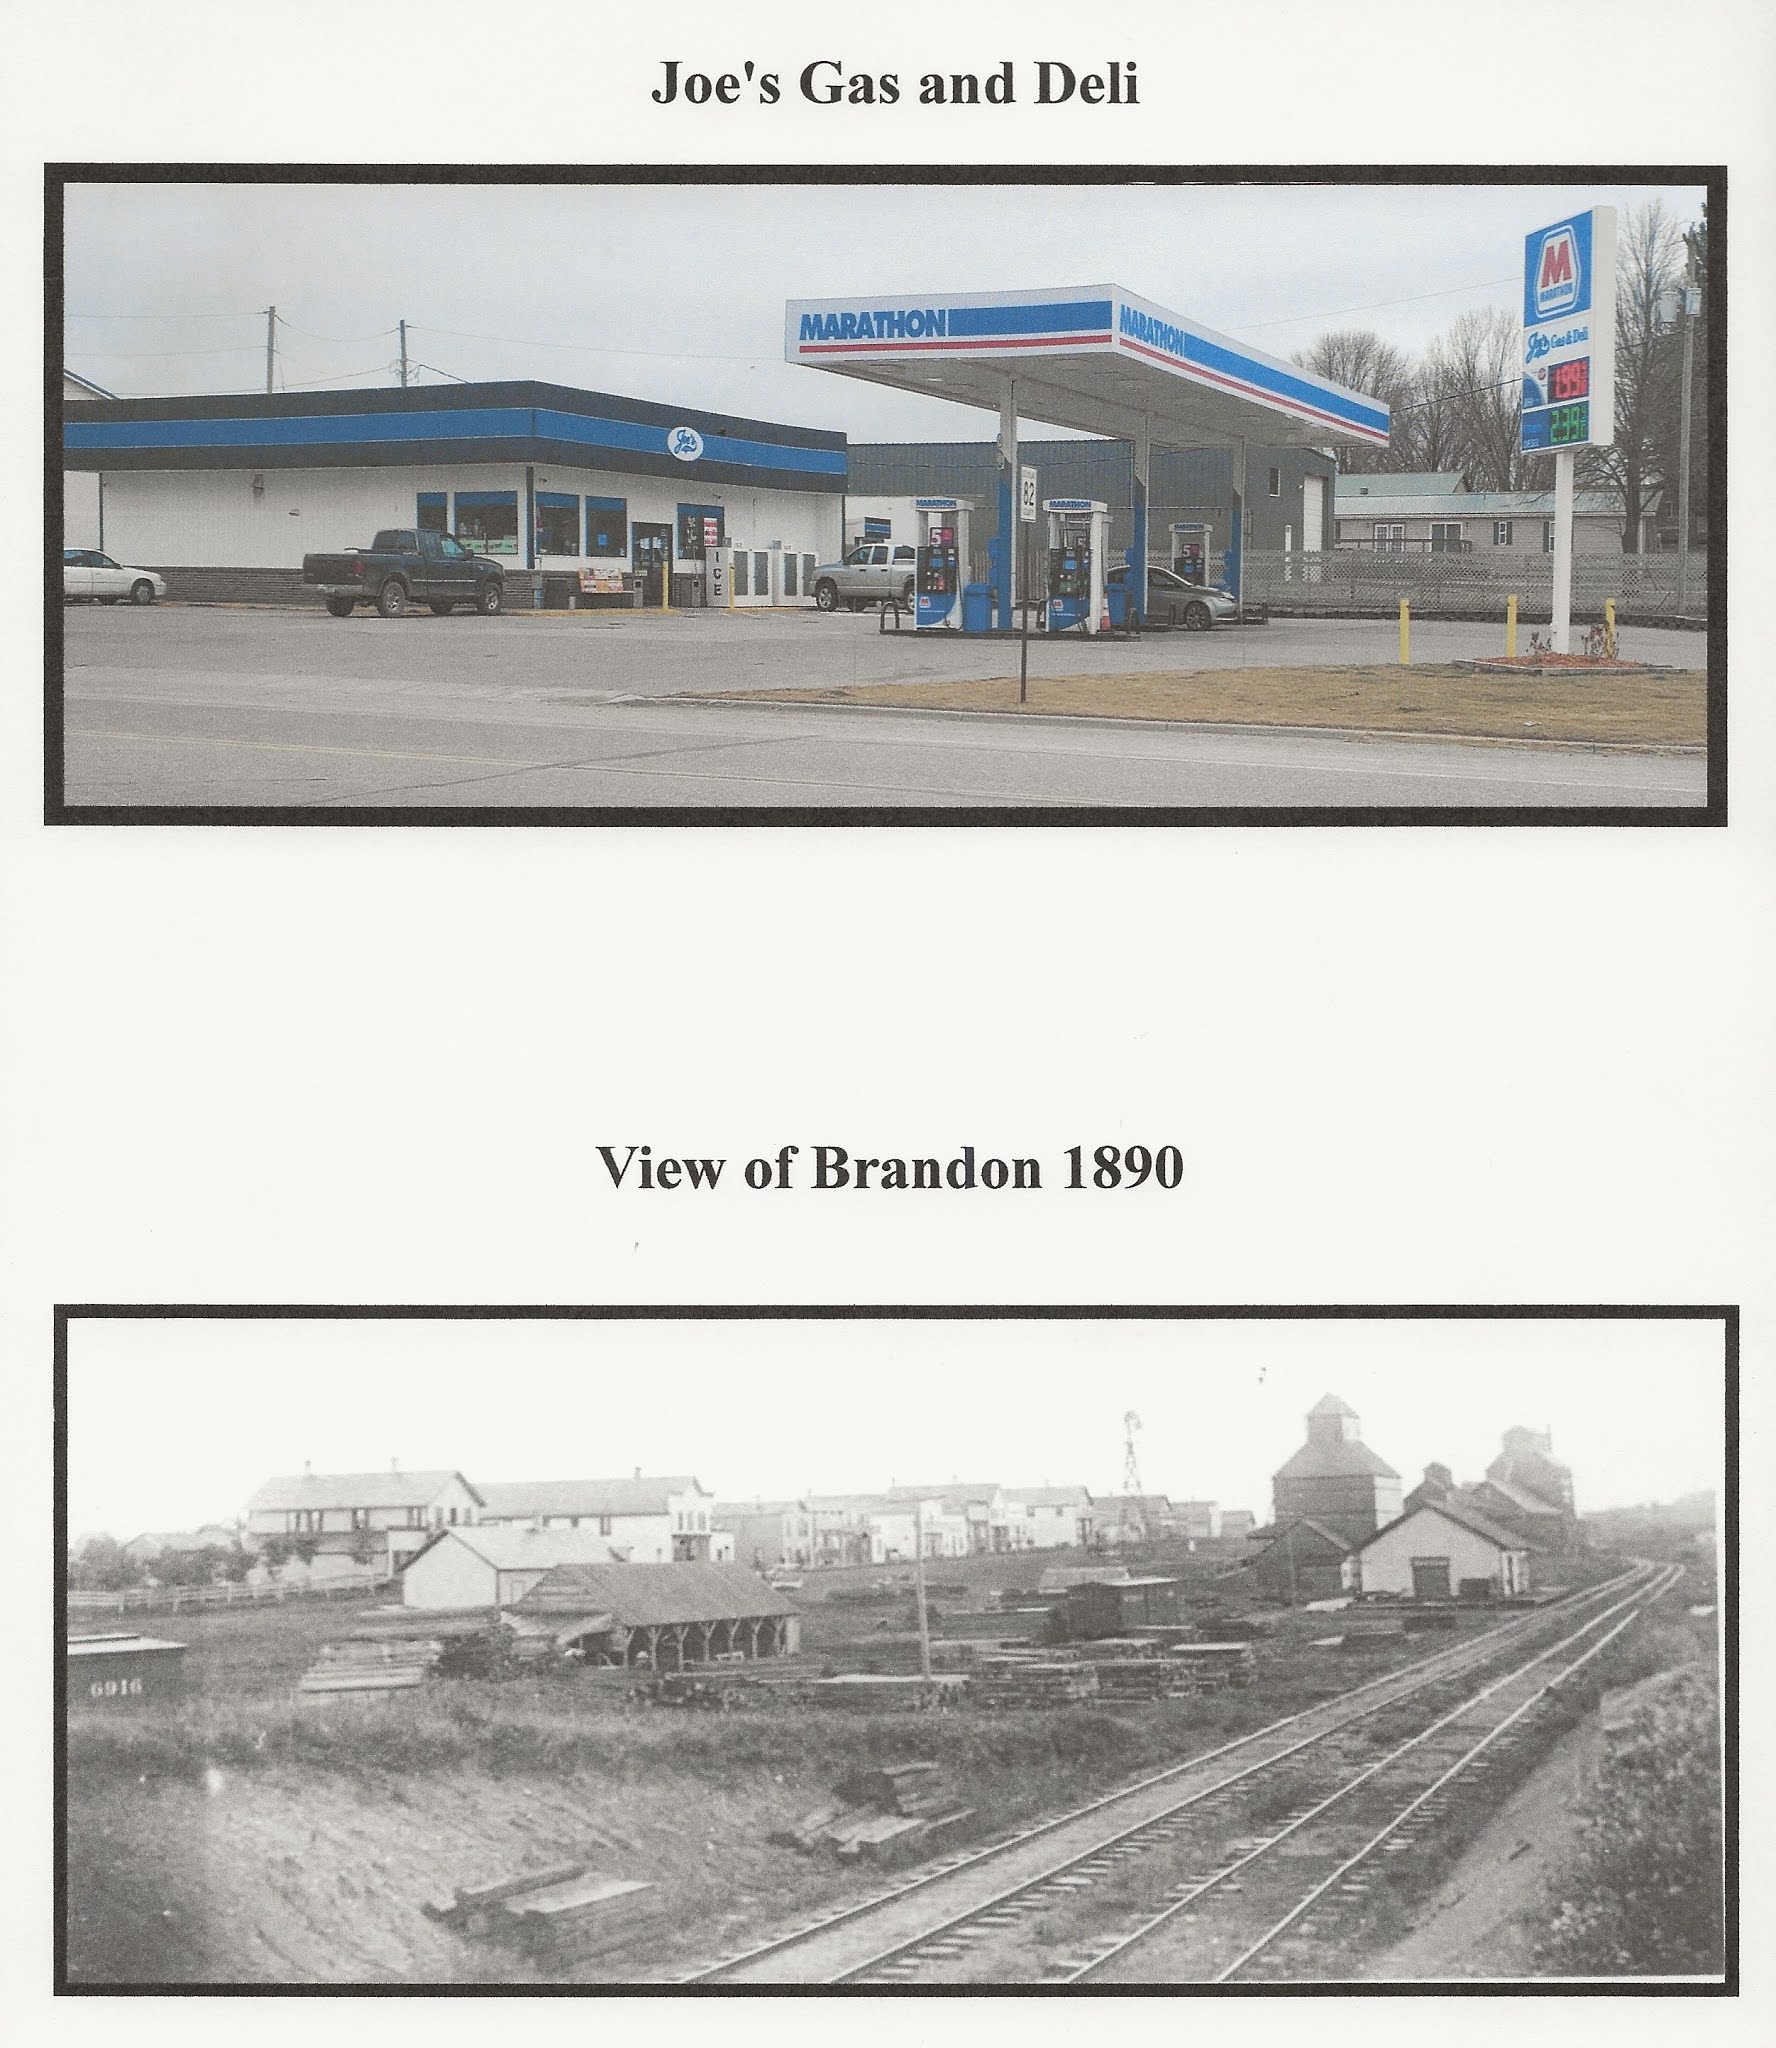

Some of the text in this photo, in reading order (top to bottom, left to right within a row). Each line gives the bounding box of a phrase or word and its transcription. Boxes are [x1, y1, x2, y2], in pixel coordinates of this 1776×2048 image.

[651, 60, 1141, 105] Joe's Gas and Deli
[1541, 240, 1572, 288] M
[798, 308, 947, 342] MARATHON
[1119, 303, 1186, 357] MARATHON
[916, 499, 957, 508] MARATHON
[1023, 481, 1035, 506] 82
[1049, 500, 1092, 509] MARATHON
[1182, 545, 1191, 558] 5
[712, 551, 723, 597] ICE
[594, 1145, 1184, 1190] View of Brandon 1890
[90, 1677, 143, 1697] 6916
